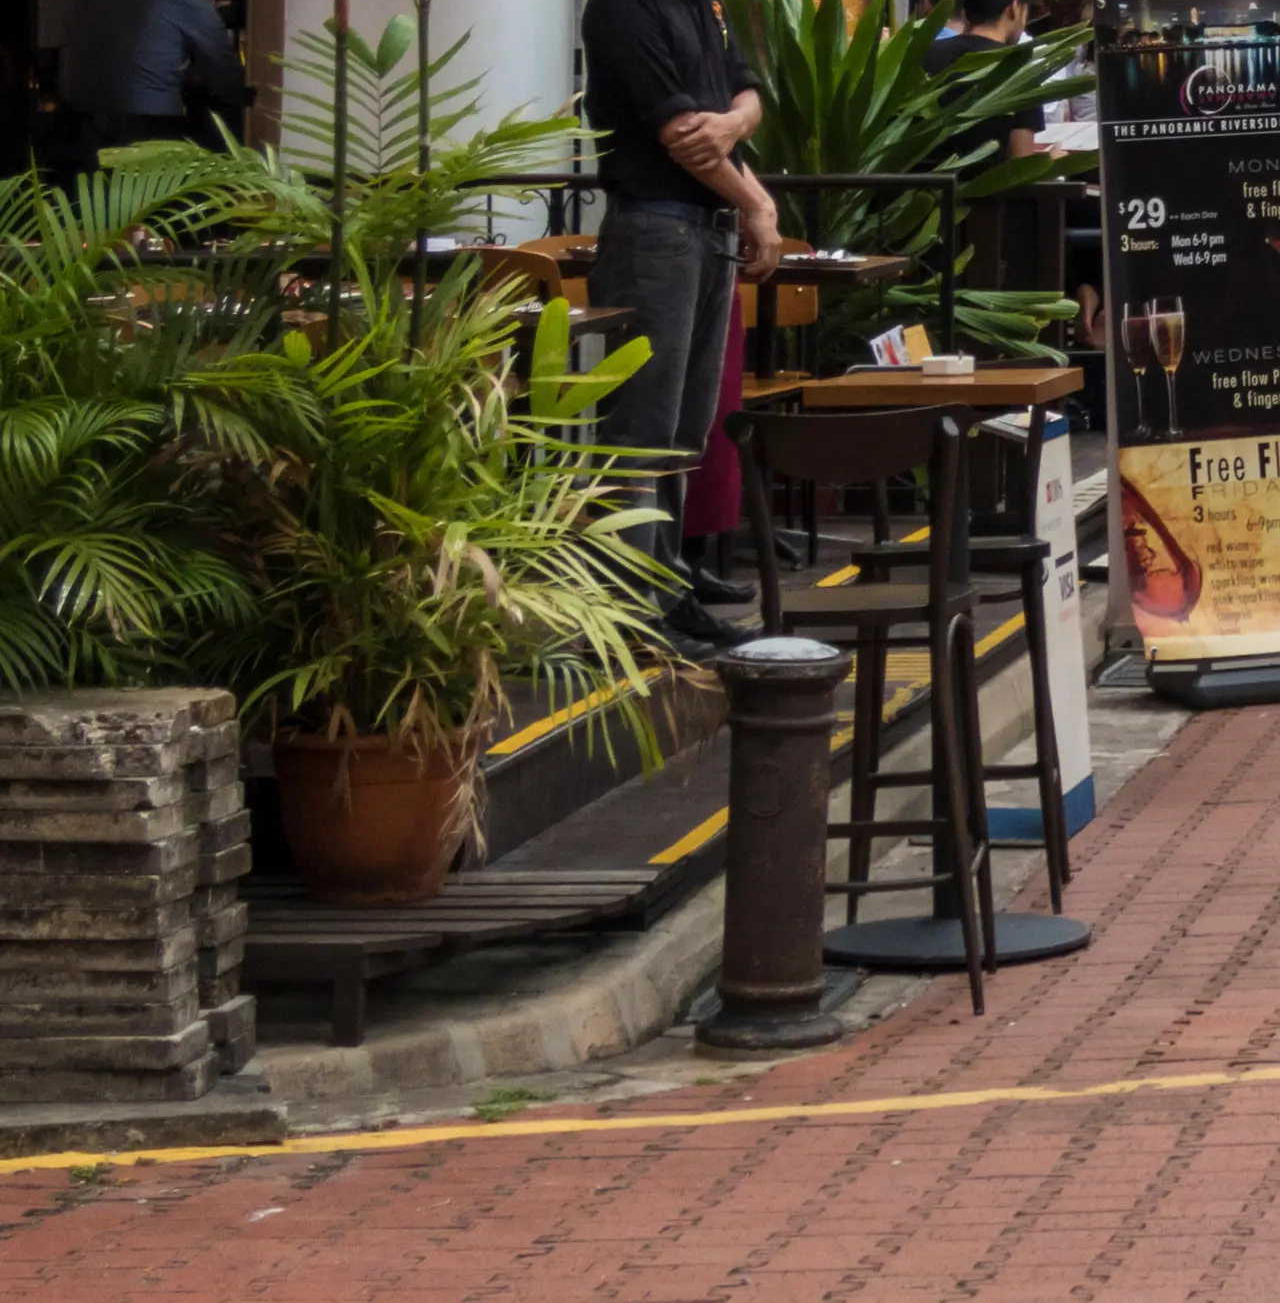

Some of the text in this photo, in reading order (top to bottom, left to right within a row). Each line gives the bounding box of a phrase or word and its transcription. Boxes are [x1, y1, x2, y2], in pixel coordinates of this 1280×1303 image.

[1198, 82, 1277, 95] PANORAMA
[1114, 126, 1136, 137] THE
[1143, 121, 1214, 135] PANORAMIC
[1243, 182, 1268, 198] free
[1247, 205, 1256, 218] &
[1121, 234, 1129, 252] 3
[1171, 236, 1191, 248] Mon
[1192, 233, 1207, 246] 6-9
[1209, 235, 1224, 248] pm
[1173, 251, 1227, 266] Wed 6-9 pm
[1212, 373, 1237, 390] free
[1242, 370, 1268, 387] flow
[1233, 394, 1242, 408] &
[1189, 447, 1245, 484] Free
[1193, 505, 1204, 523] 3
[1207, 509, 1237, 522] hours
[1206, 540, 1250, 553] red wine
[1208, 557, 1264, 570] white wine
[1210, 574, 1256, 590] sparkling
[1212, 592, 1233, 607] pink
